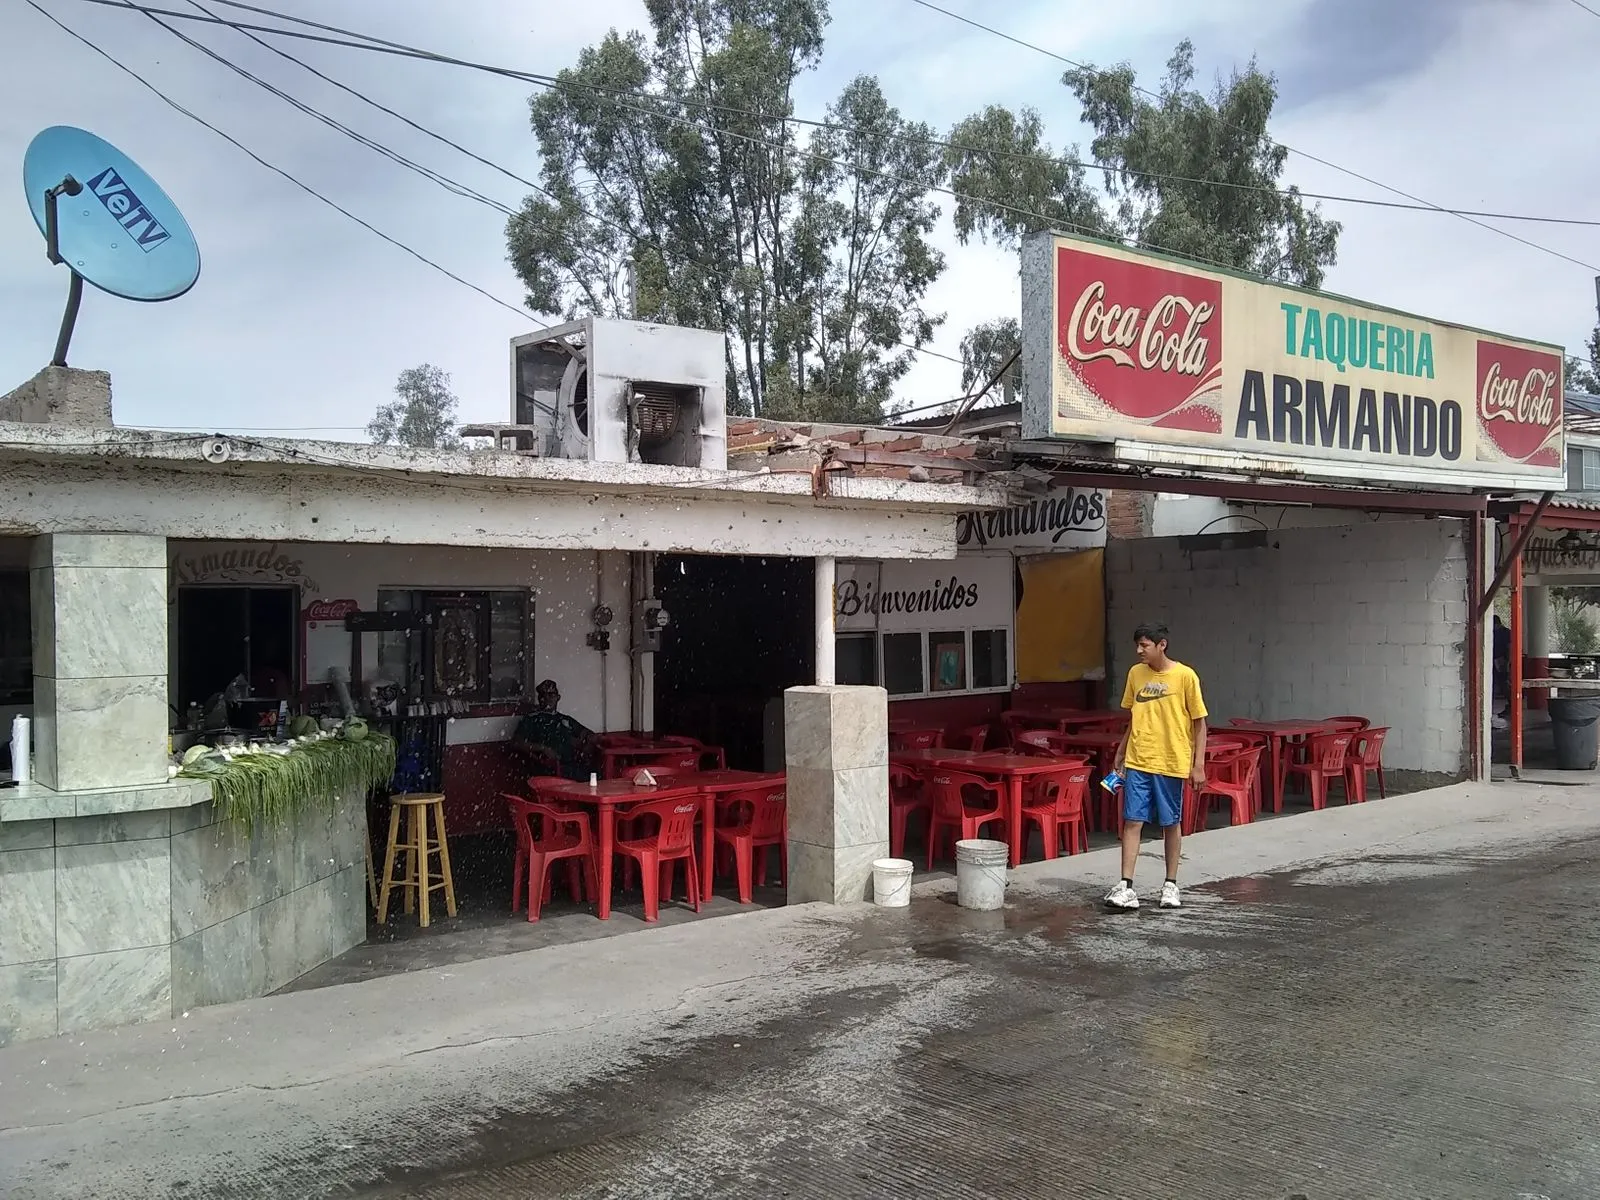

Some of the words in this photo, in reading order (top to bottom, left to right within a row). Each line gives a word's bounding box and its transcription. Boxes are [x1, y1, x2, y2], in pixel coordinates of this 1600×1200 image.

[93, 169, 168, 246] VeTV
[1280, 302, 1435, 380] TAQUERIA
[1234, 368, 1462, 461] ARMANDO
[835, 576, 979, 617] Bienvenidos
